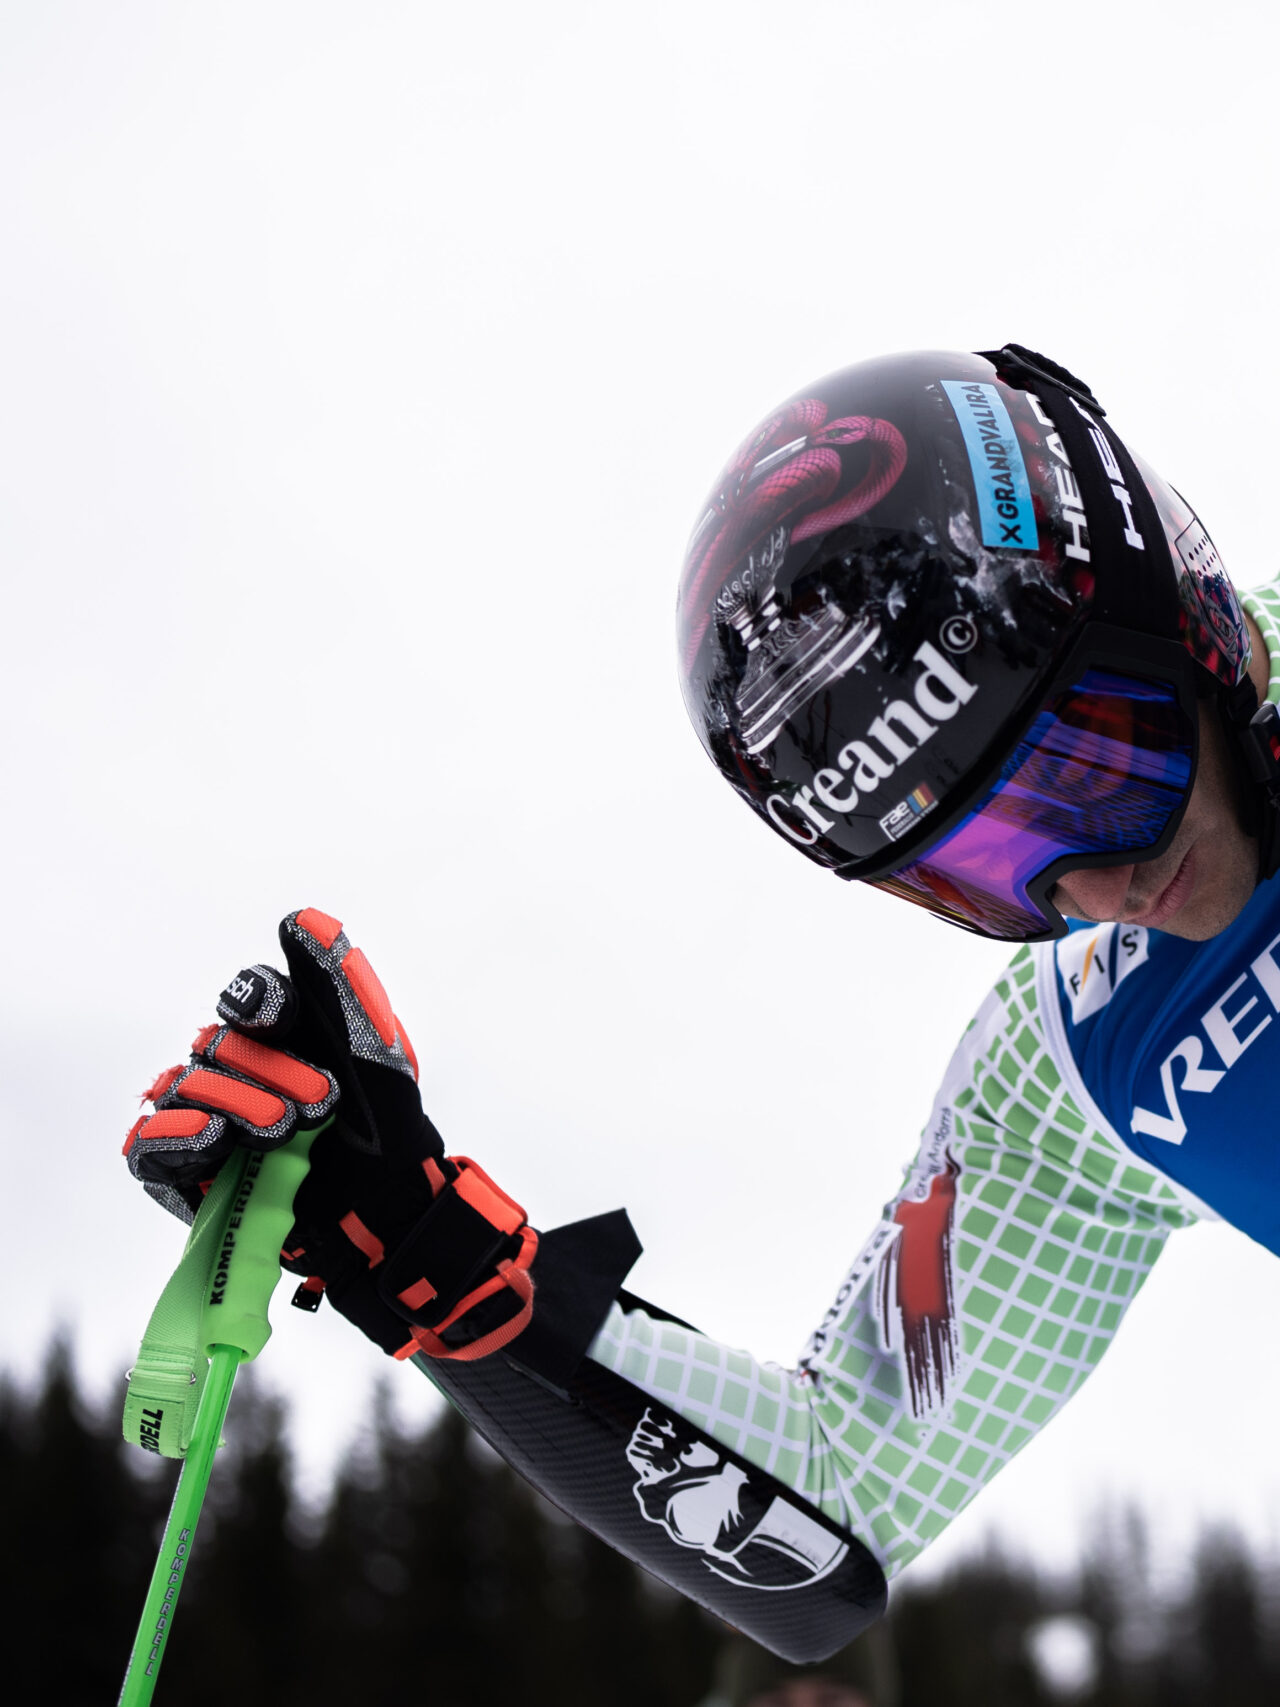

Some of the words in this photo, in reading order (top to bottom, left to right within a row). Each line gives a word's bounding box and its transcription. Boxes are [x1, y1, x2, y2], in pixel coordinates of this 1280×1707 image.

[960, 384, 1020, 520] GRANDVALIRA
[1069, 931, 1138, 996] FIS
[209, 1152, 265, 1306] KOMPERDEL
[145, 1528, 191, 1677] KOMPERDELL
